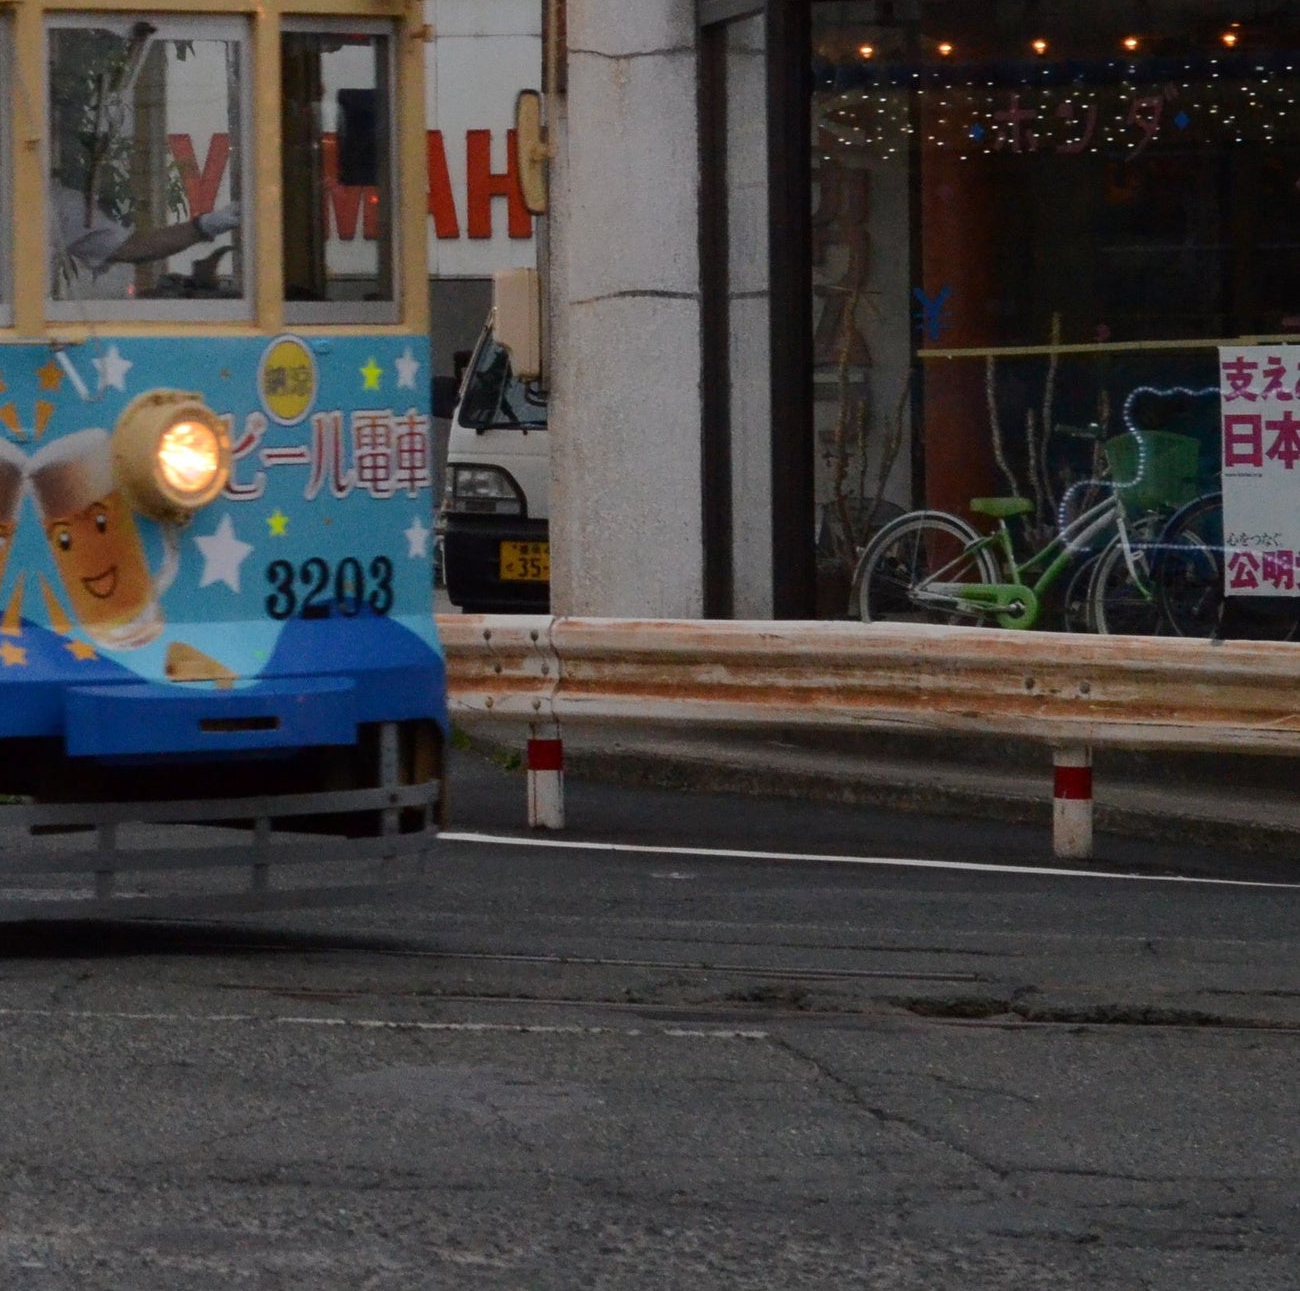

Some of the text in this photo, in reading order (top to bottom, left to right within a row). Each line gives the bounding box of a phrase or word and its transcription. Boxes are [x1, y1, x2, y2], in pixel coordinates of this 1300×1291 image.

[1222, 355, 1300, 403] 支え
[224, 409, 432, 500] ビール電車
[264, 556, 395, 620] 3203
[1227, 549, 1300, 591] 公明
